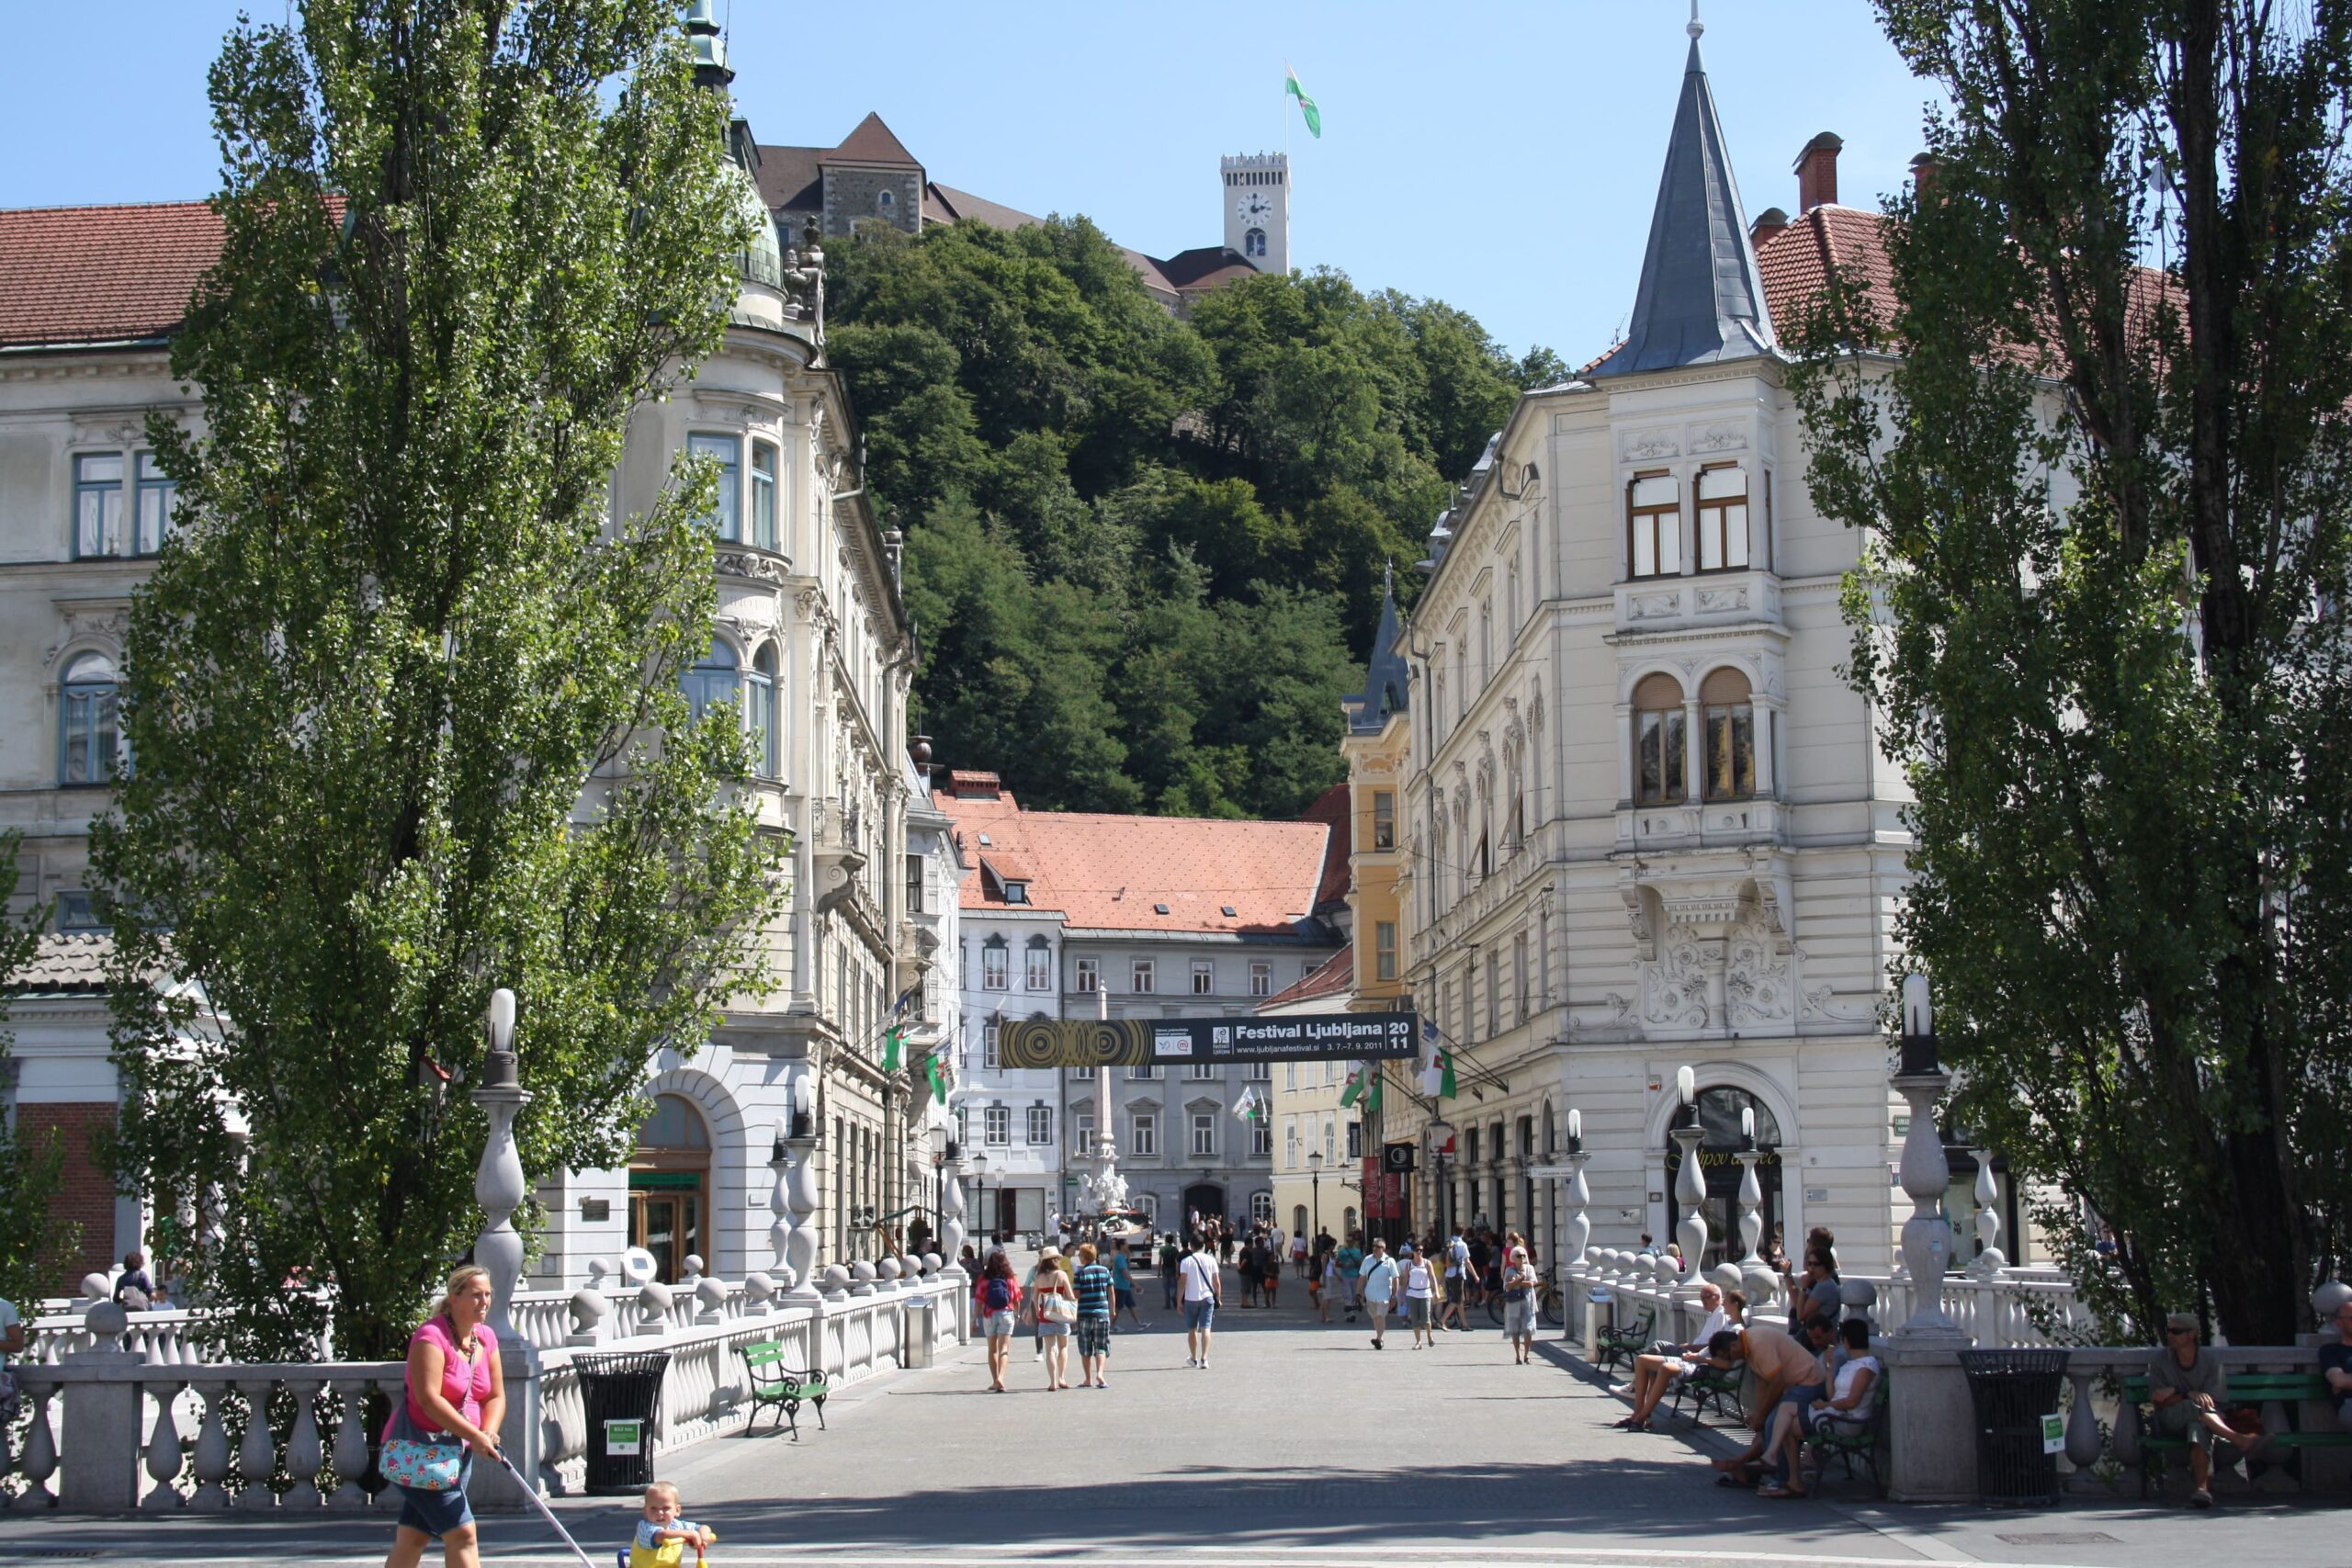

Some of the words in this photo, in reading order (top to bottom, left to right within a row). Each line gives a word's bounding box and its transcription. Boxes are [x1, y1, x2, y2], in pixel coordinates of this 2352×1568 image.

[1236, 1024, 1301, 1040] Festival
[1306, 1022, 1383, 1040] Ljubljana
[1388, 1021, 1409, 1035] 20
[1236, 1043, 1320, 1055] www.ljubljanafestival.si
[1364, 1042, 1383, 1050] 2011
[1390, 1036, 1408, 1049] 11
